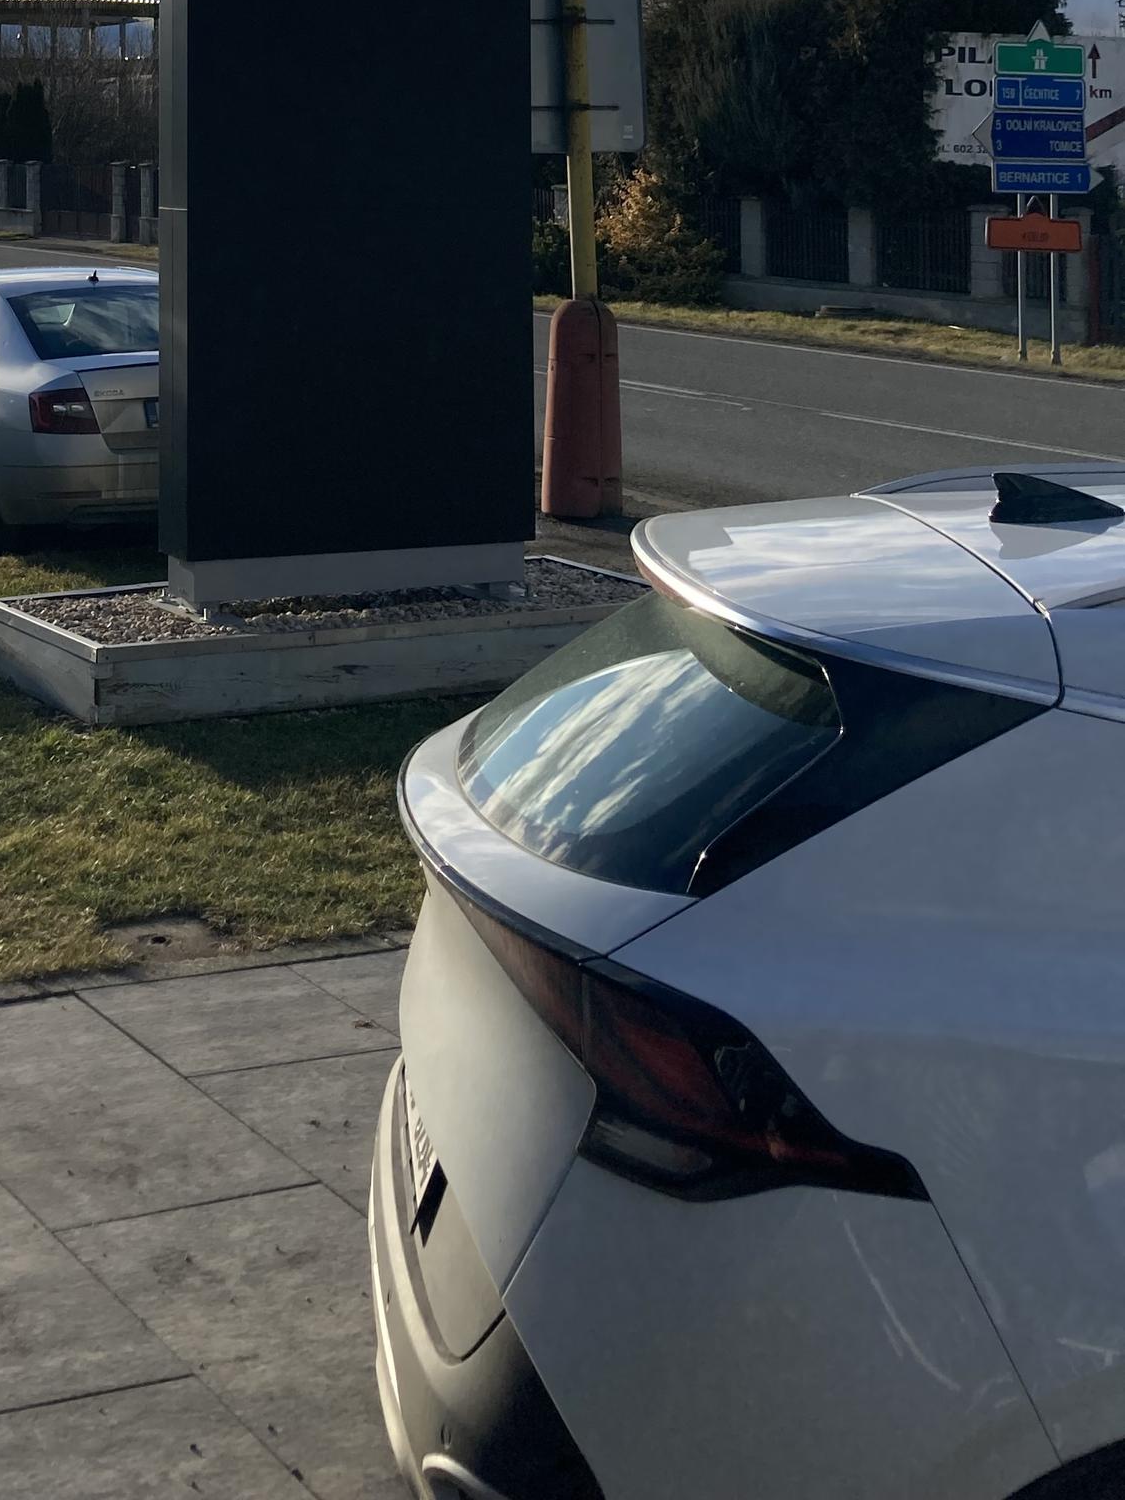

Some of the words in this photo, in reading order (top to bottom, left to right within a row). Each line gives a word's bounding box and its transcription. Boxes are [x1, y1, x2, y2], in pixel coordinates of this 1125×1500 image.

[945, 79, 993, 97] LO
[1089, 85, 1112, 99] km
[1075, 89, 1081, 101] 7
[995, 119, 1002, 130] 5
[1005, 116, 1033, 132] DOLNÍ
[1033, 119, 1082, 132] KRALOVICE
[953, 144, 974, 153] 602
[995, 139, 1003, 151] 3
[1049, 140, 1083, 152] TOMICE
[999, 171, 1070, 184] BERNARTICE
[1076, 172, 1082, 184] 1
